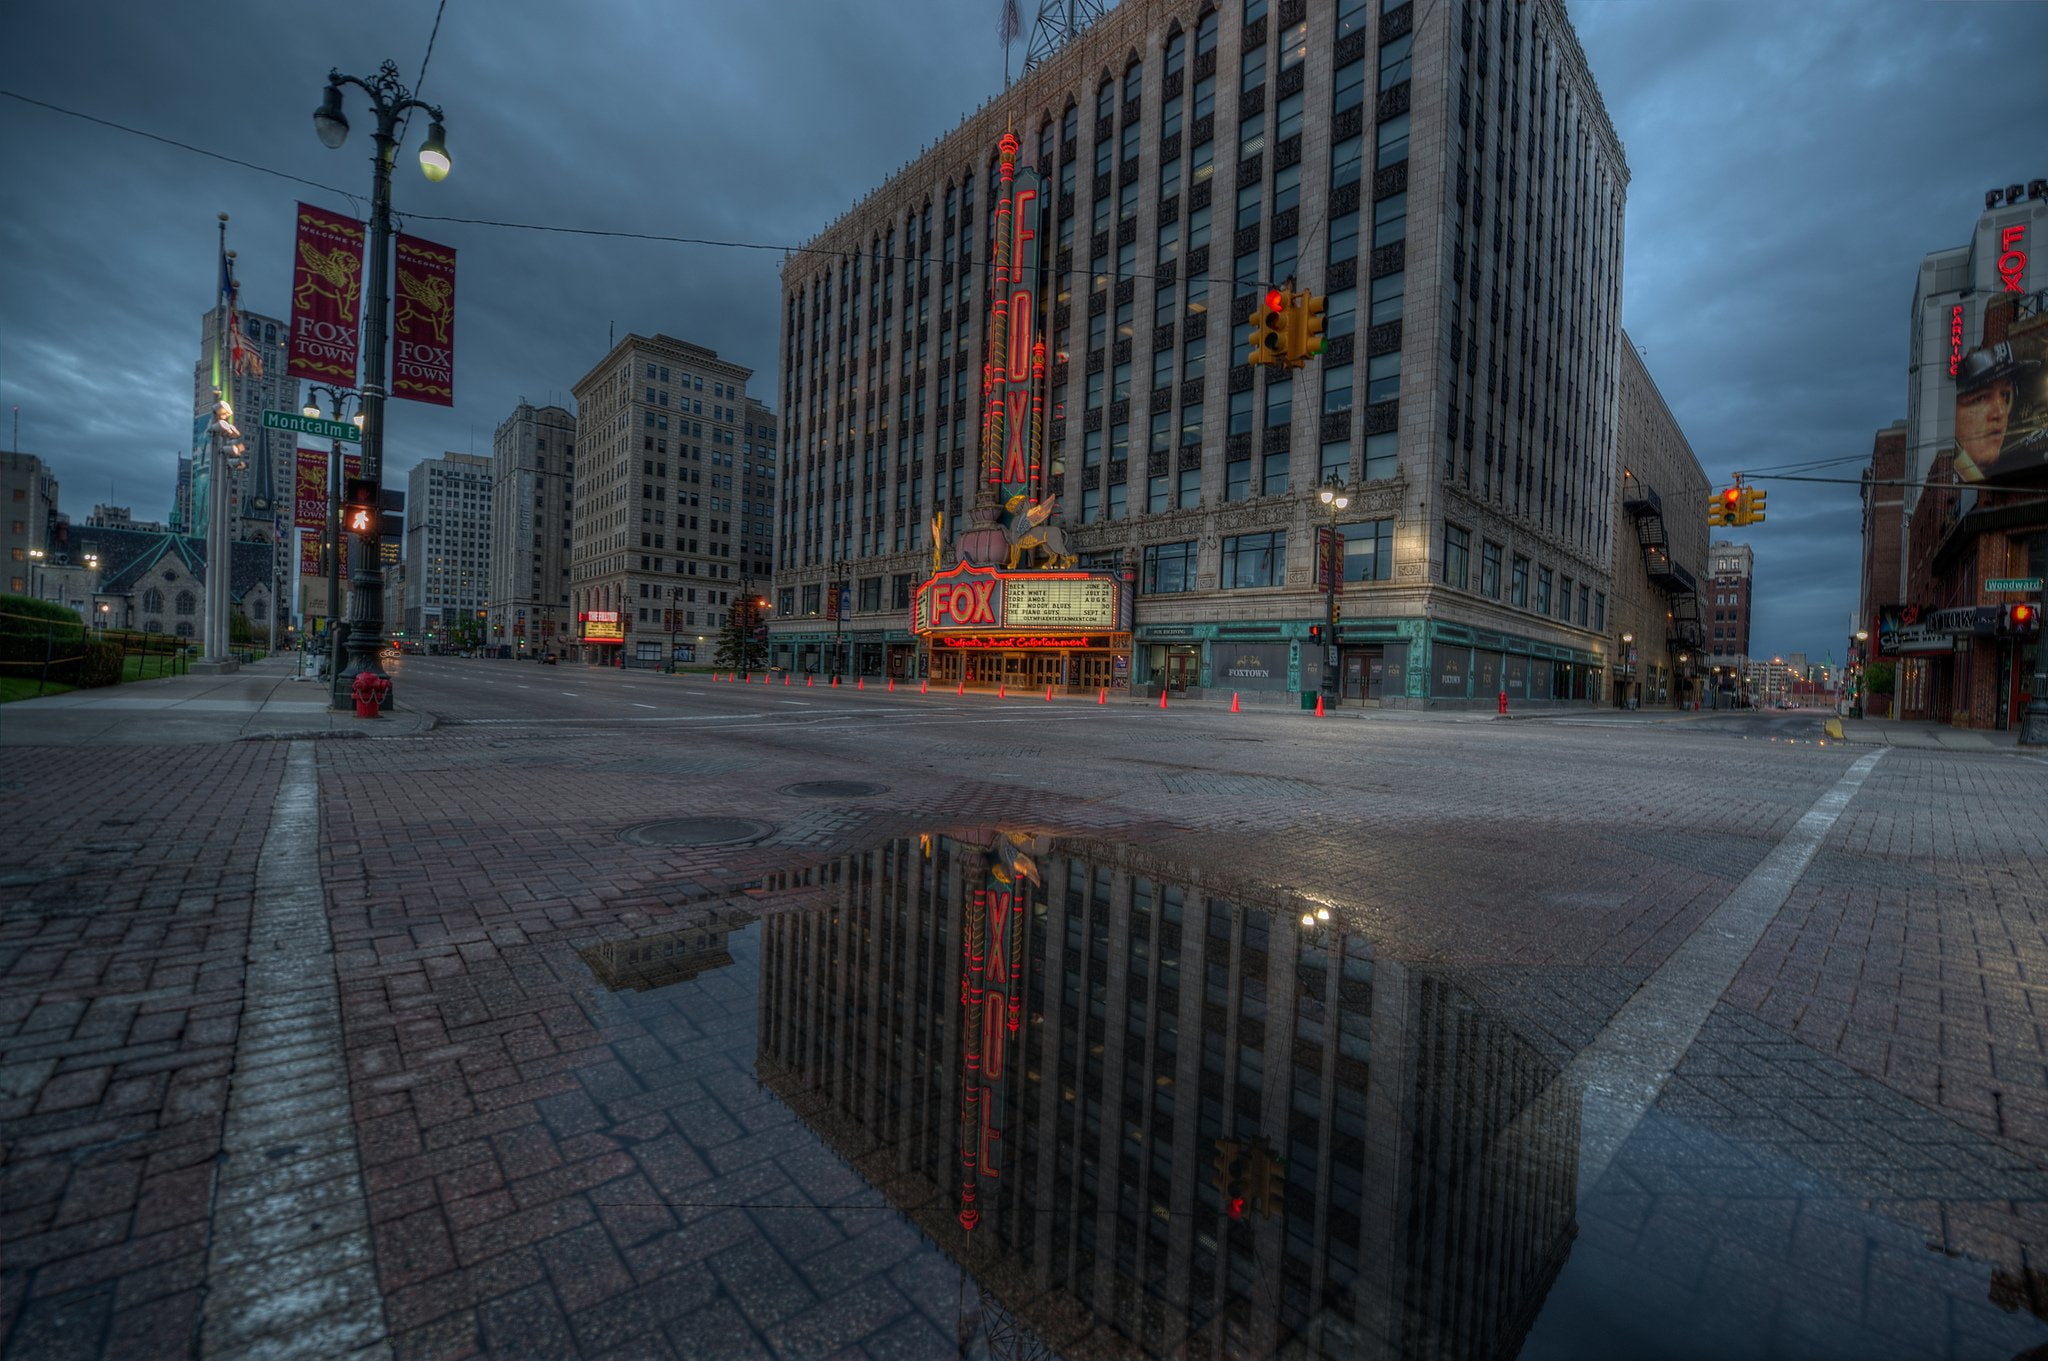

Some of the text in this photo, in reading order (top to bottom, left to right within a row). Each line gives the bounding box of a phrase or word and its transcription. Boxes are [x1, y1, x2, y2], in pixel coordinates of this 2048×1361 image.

[300, 224, 363, 248] WELCOME TO
[398, 254, 441, 271] WELCOME
[1997, 224, 2028, 295] FOX
[297, 315, 356, 347] FOX
[1003, 189, 1037, 484] FOX
[1949, 305, 1964, 376] PARKING
[295, 339, 354, 364] TOWN
[398, 339, 452, 368] FOX
[397, 362, 452, 383] TOWN
[268, 413, 356, 439] Montcalm E
[297, 510, 326, 519] TOWN
[298, 499, 326, 511] FOX
[1989, 580, 2039, 590] Woodward
[932, 580, 996, 625] FOX
[1016, 636, 1089, 648] Entertainment
[1228, 668, 1270, 678] FOXTOWN
